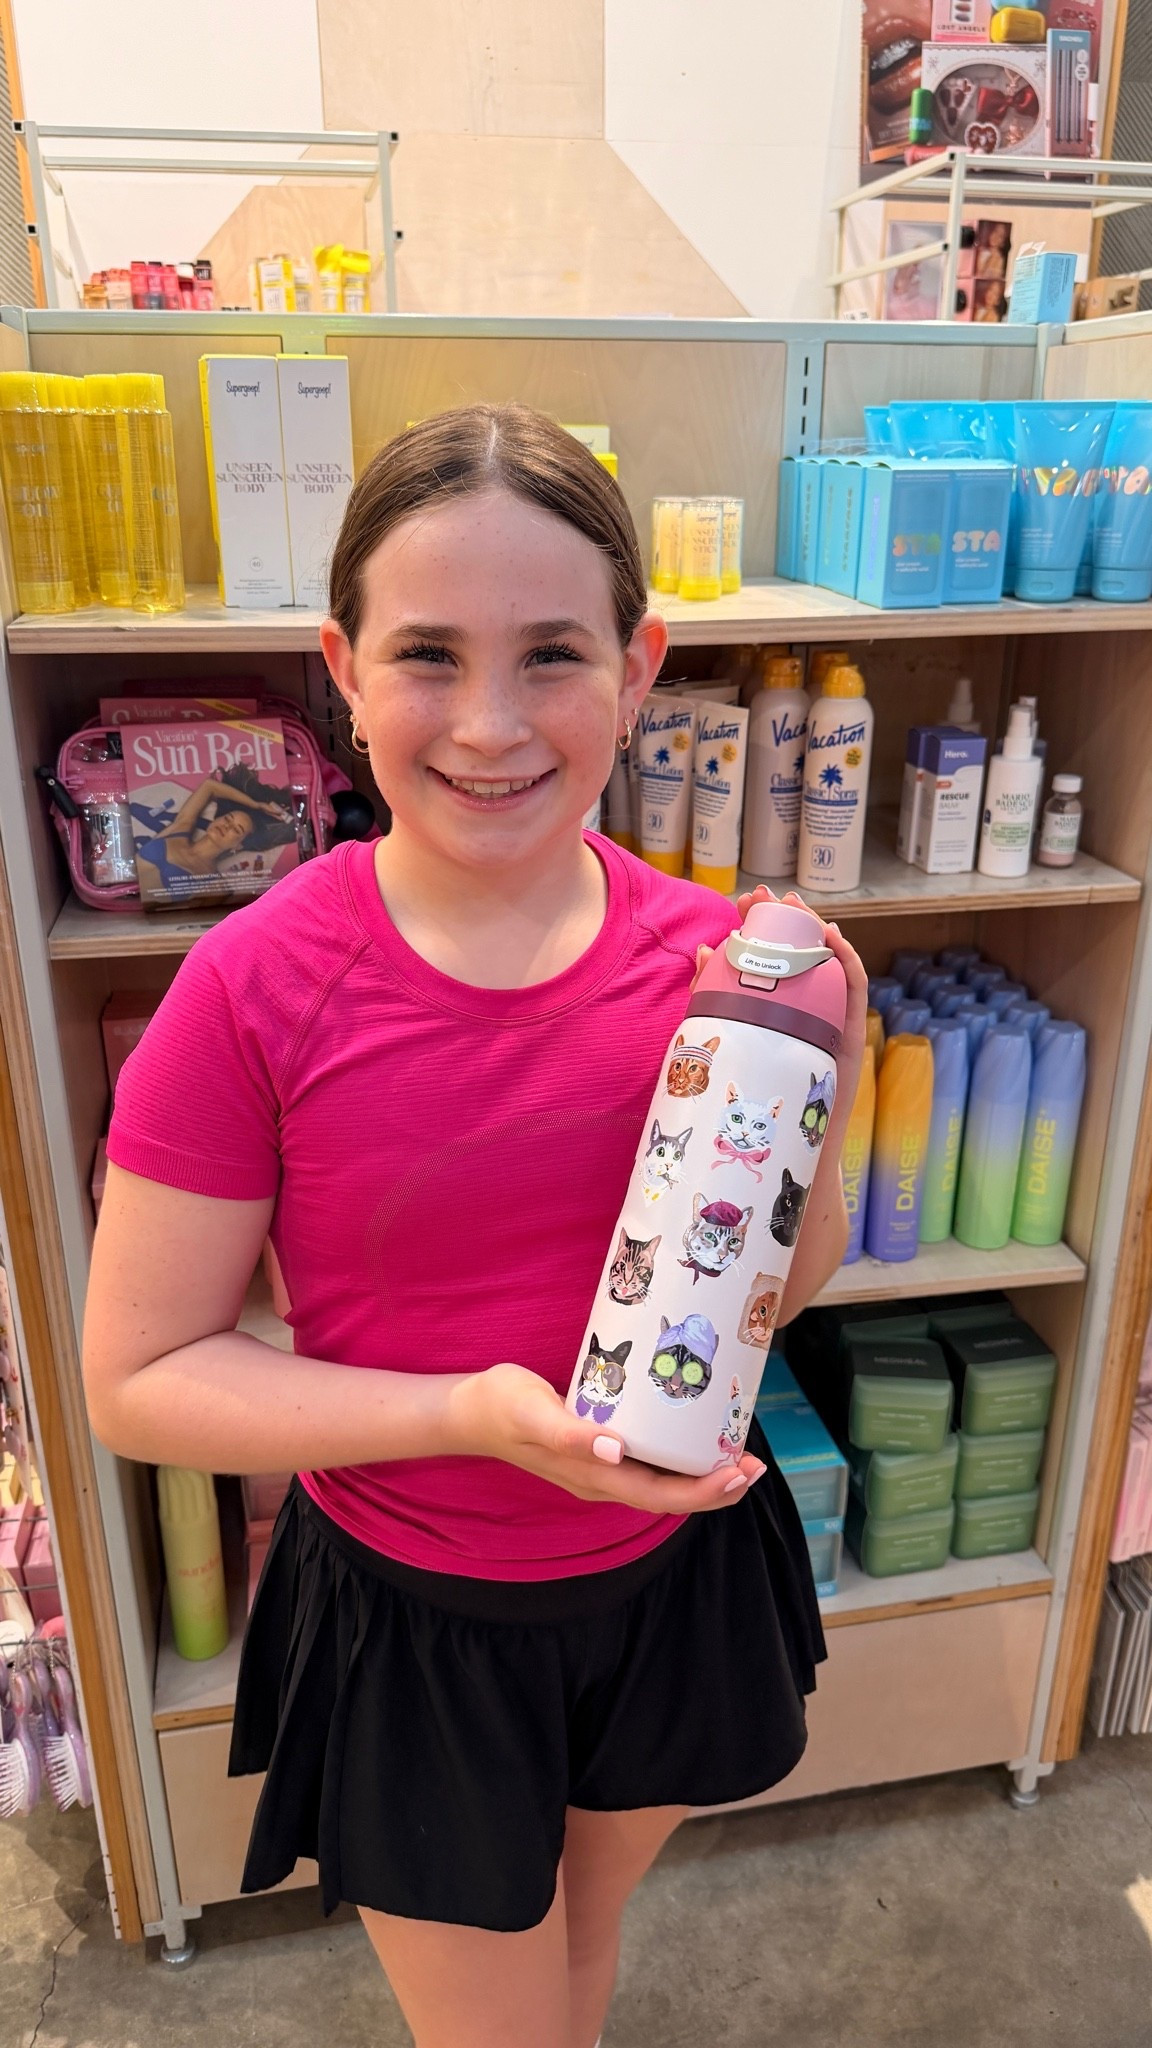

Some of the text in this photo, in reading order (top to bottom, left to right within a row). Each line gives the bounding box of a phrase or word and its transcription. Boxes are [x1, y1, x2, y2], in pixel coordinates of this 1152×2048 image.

[226, 380, 260, 397] Supergoop!
[297, 382, 331, 398] Supergoop!
[226, 463, 273, 472] UNSEEN
[296, 464, 343, 473] UNSEEN
[217, 473, 284, 482] SUNSCREEN
[286, 474, 353, 483] SUNSCREEN
[234, 483, 266, 493] BODY
[304, 484, 336, 494] BODY
[952, 530, 1001, 553] STA
[641, 708, 693, 736] Vacation
[696, 716, 741, 744] Vacation
[155, 730, 196, 743] Vacation
[806, 721, 866, 753] Vacation
[133, 736, 203, 777] Sun
[204, 732, 277, 773] Belt
[832, 785, 859, 800] Spray
[940, 793, 970, 801] RESCUE
[1002, 793, 1030, 801] MARIO
[813, 847, 832, 866] 30
[1028, 1119, 1057, 1195] DAISE
[843, 1137, 865, 1214] DAISE
[895, 1134, 922, 1211] DAISE
